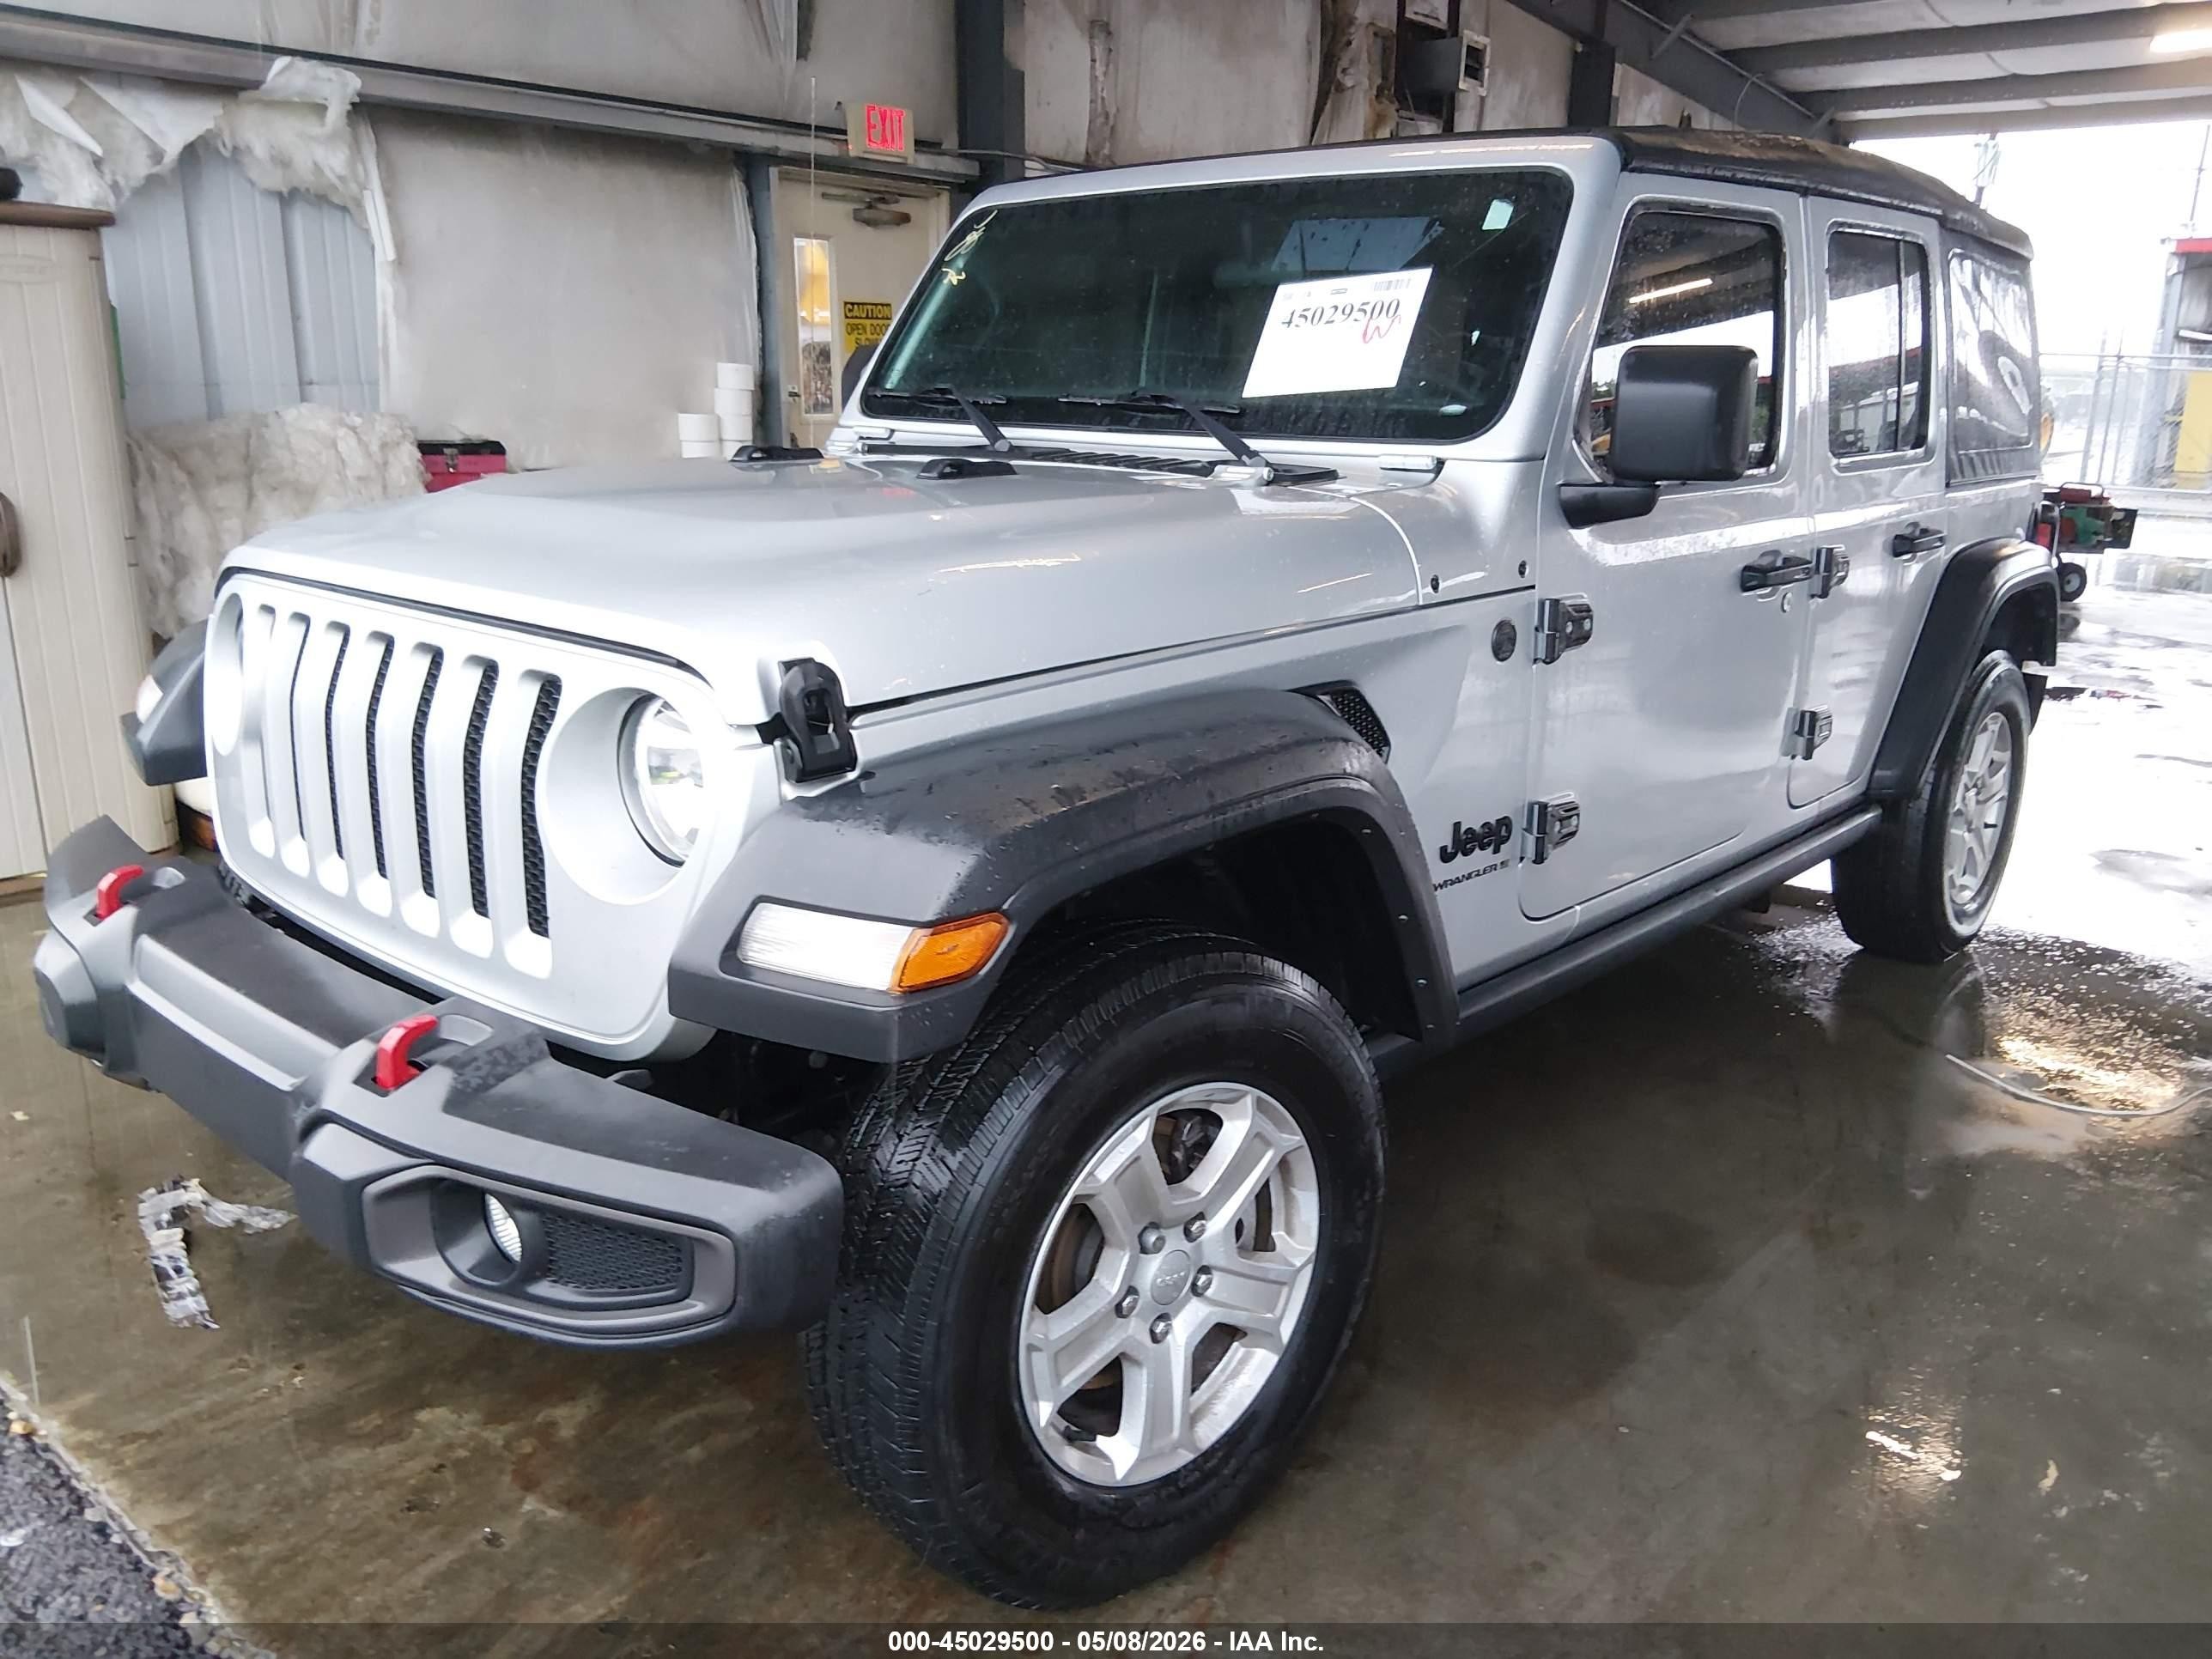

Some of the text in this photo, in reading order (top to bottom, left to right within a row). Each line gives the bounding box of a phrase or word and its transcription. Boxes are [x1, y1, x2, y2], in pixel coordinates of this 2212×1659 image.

[866, 104, 905, 151] EXIT
[845, 304, 891, 318] CAUTION
[1281, 298, 1401, 328] 45029500
[846, 322, 866, 336] OPEN
[1439, 815, 1512, 864] Jeep
[1432, 863, 1498, 891] WRANGLER
